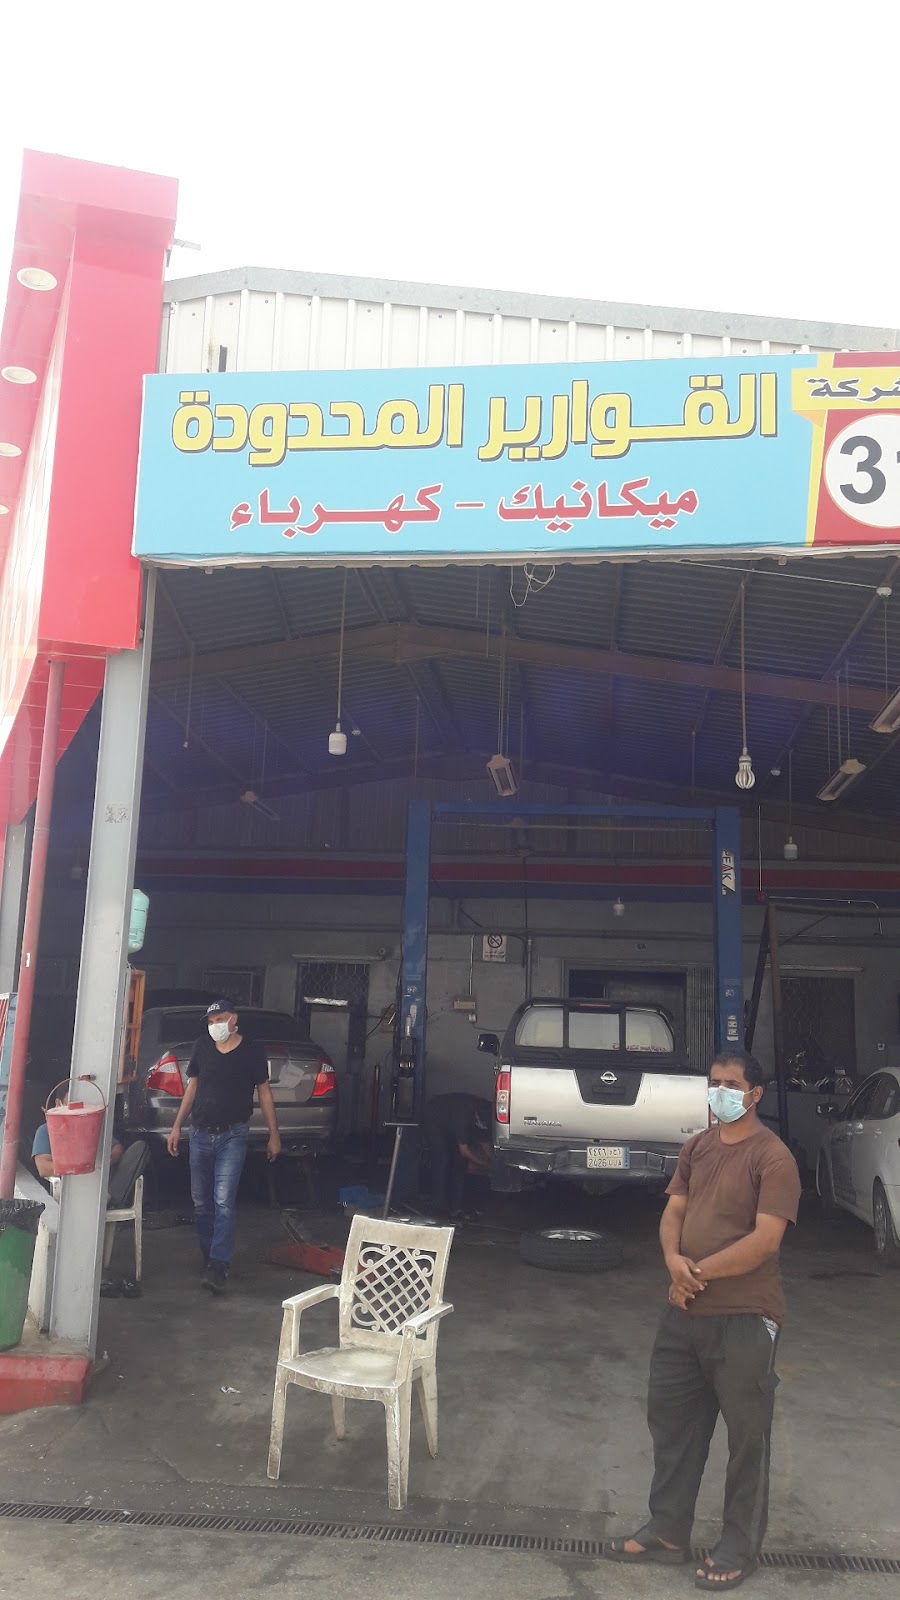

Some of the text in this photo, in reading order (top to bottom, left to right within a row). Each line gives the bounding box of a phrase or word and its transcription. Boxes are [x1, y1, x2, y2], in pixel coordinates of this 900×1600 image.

[171, 372, 778, 466] القوارير المحدودة
[840, 435, 900, 505] 3
[231, 484, 442, 538] كهرباء
[498, 477, 699, 533] ميكانيك
[523, 1119, 562, 1128] NAVARA
